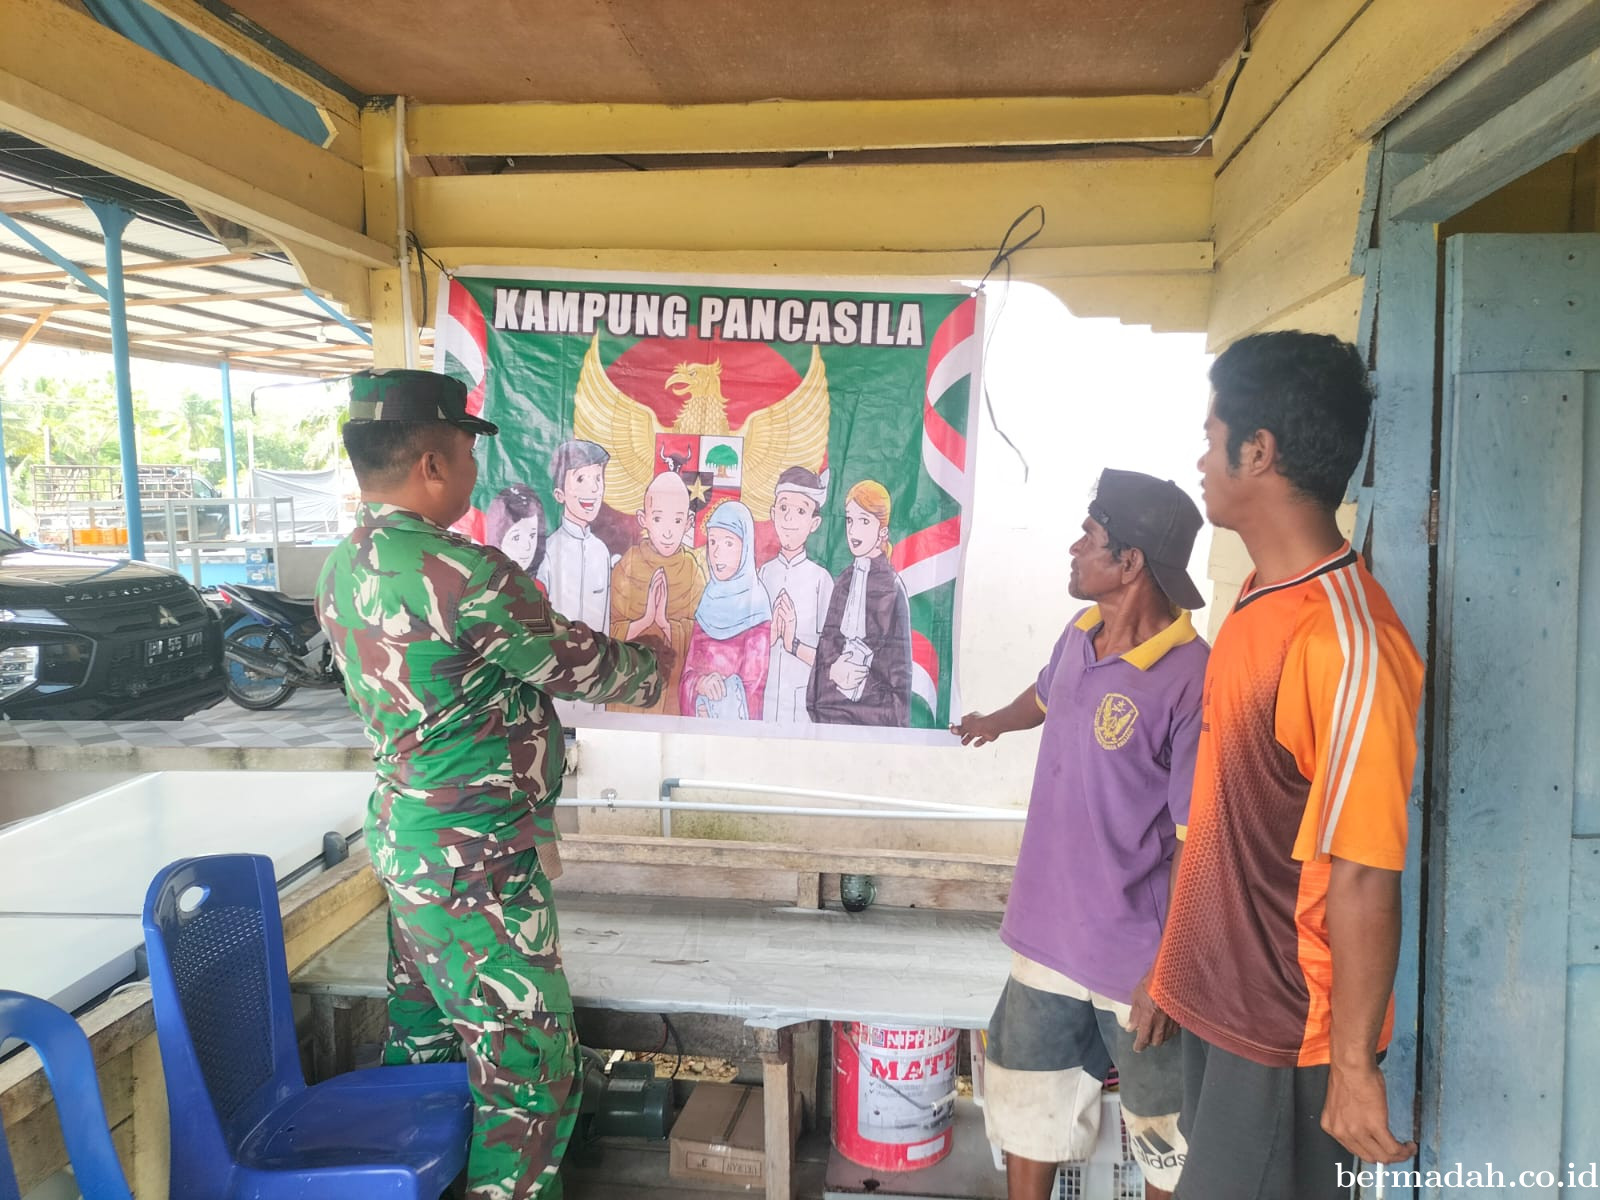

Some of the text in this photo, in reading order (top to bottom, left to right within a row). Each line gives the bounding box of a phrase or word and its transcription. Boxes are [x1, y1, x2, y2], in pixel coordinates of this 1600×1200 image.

[493, 287, 925, 346] KAMPUNG PANCASILA
[1140, 1153, 1187, 1170] idas
